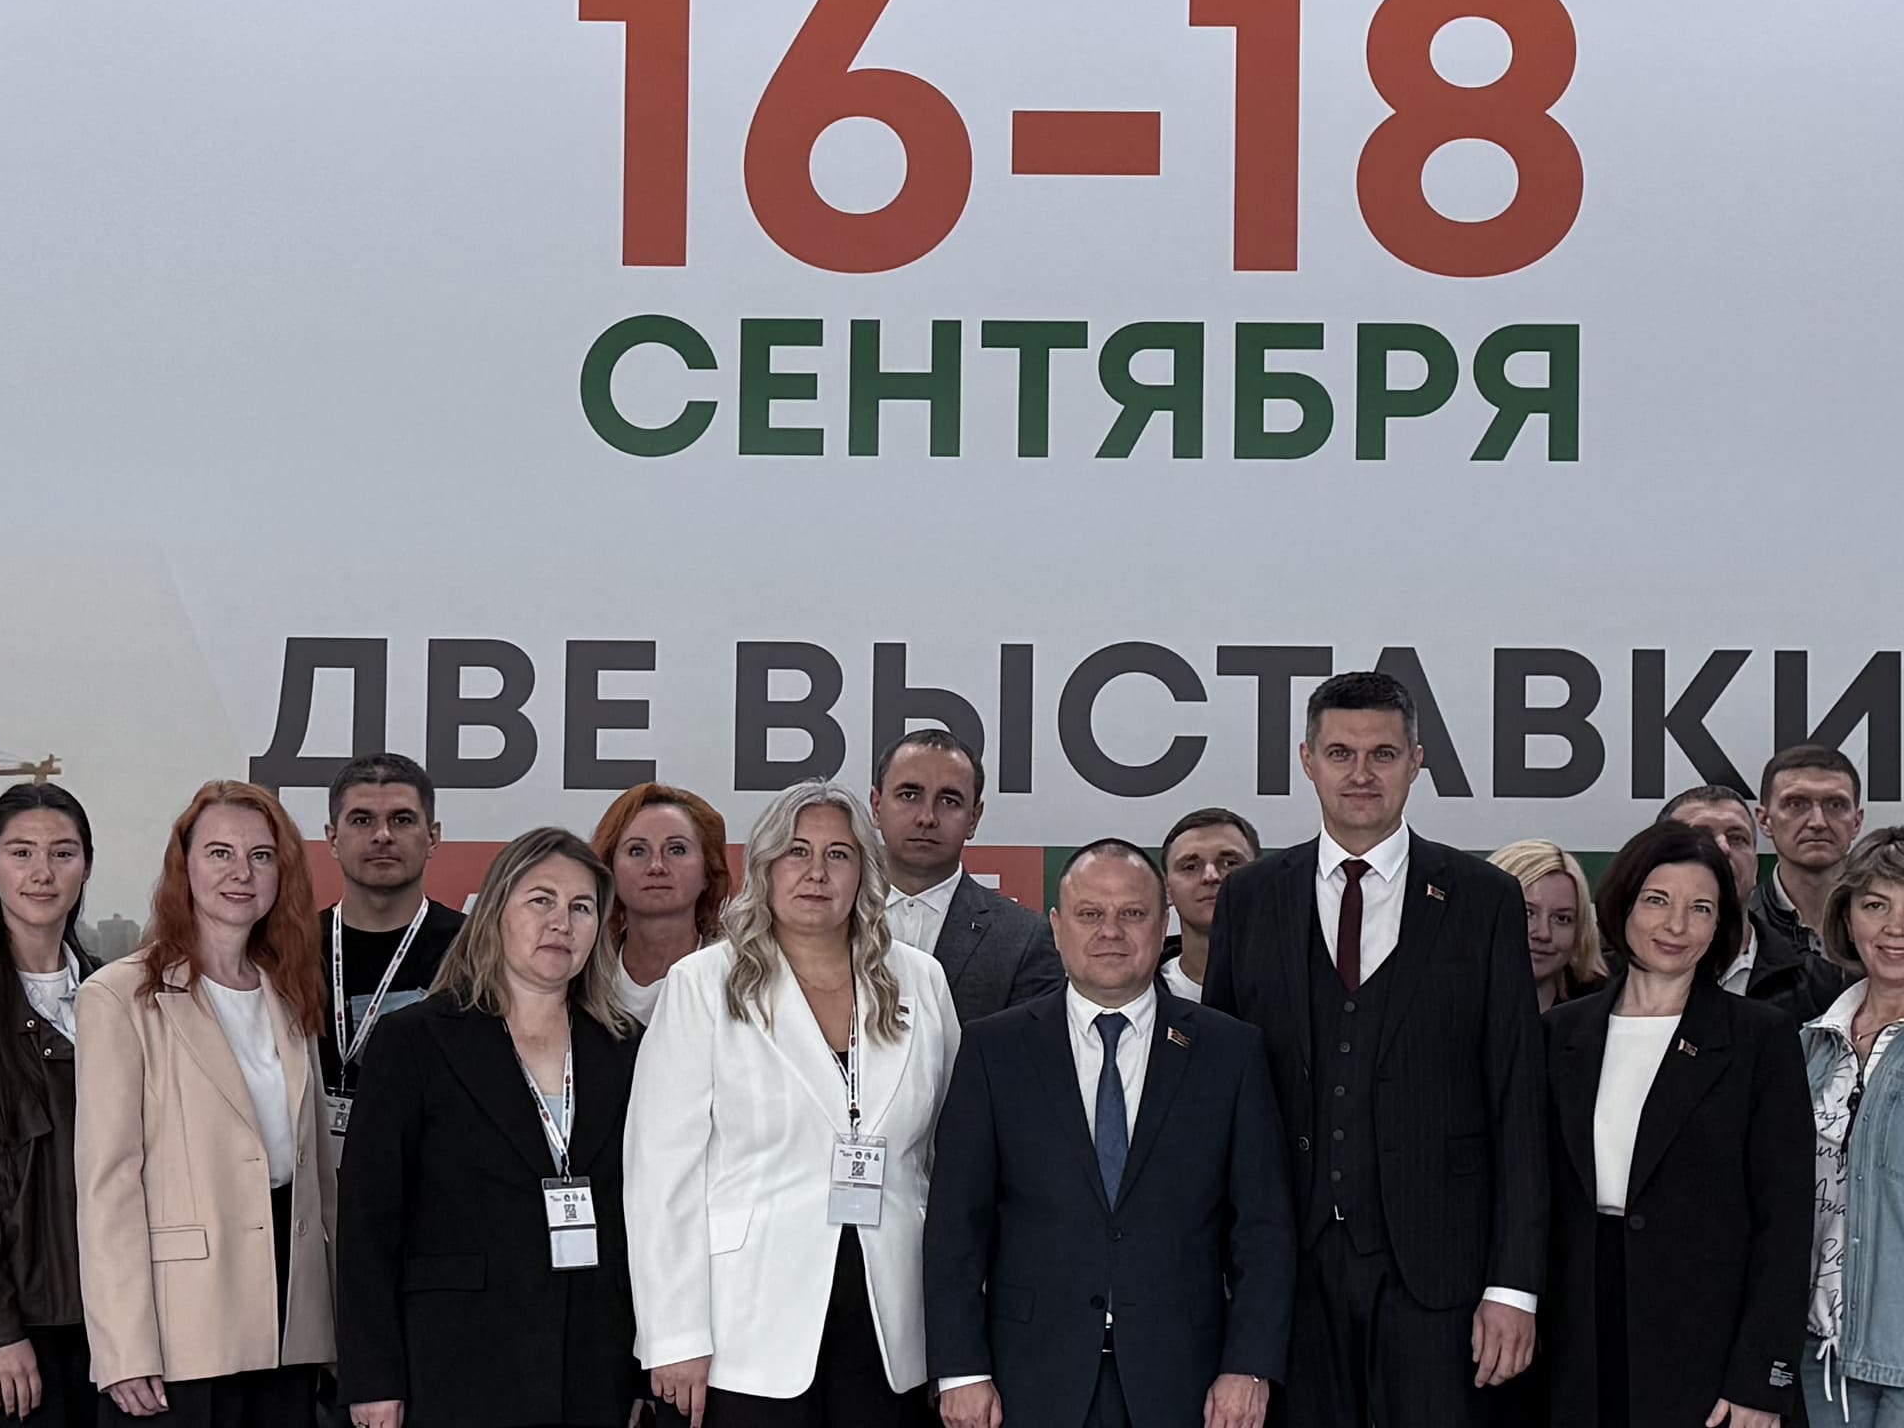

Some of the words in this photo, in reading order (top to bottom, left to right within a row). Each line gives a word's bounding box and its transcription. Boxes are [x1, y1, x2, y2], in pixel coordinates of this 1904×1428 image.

[580, 315, 1579, 461] СЕНТЯБРЯ
[249, 637, 657, 802] ДВЕ
[735, 641, 1901, 802] ВЫСТАВКИ
